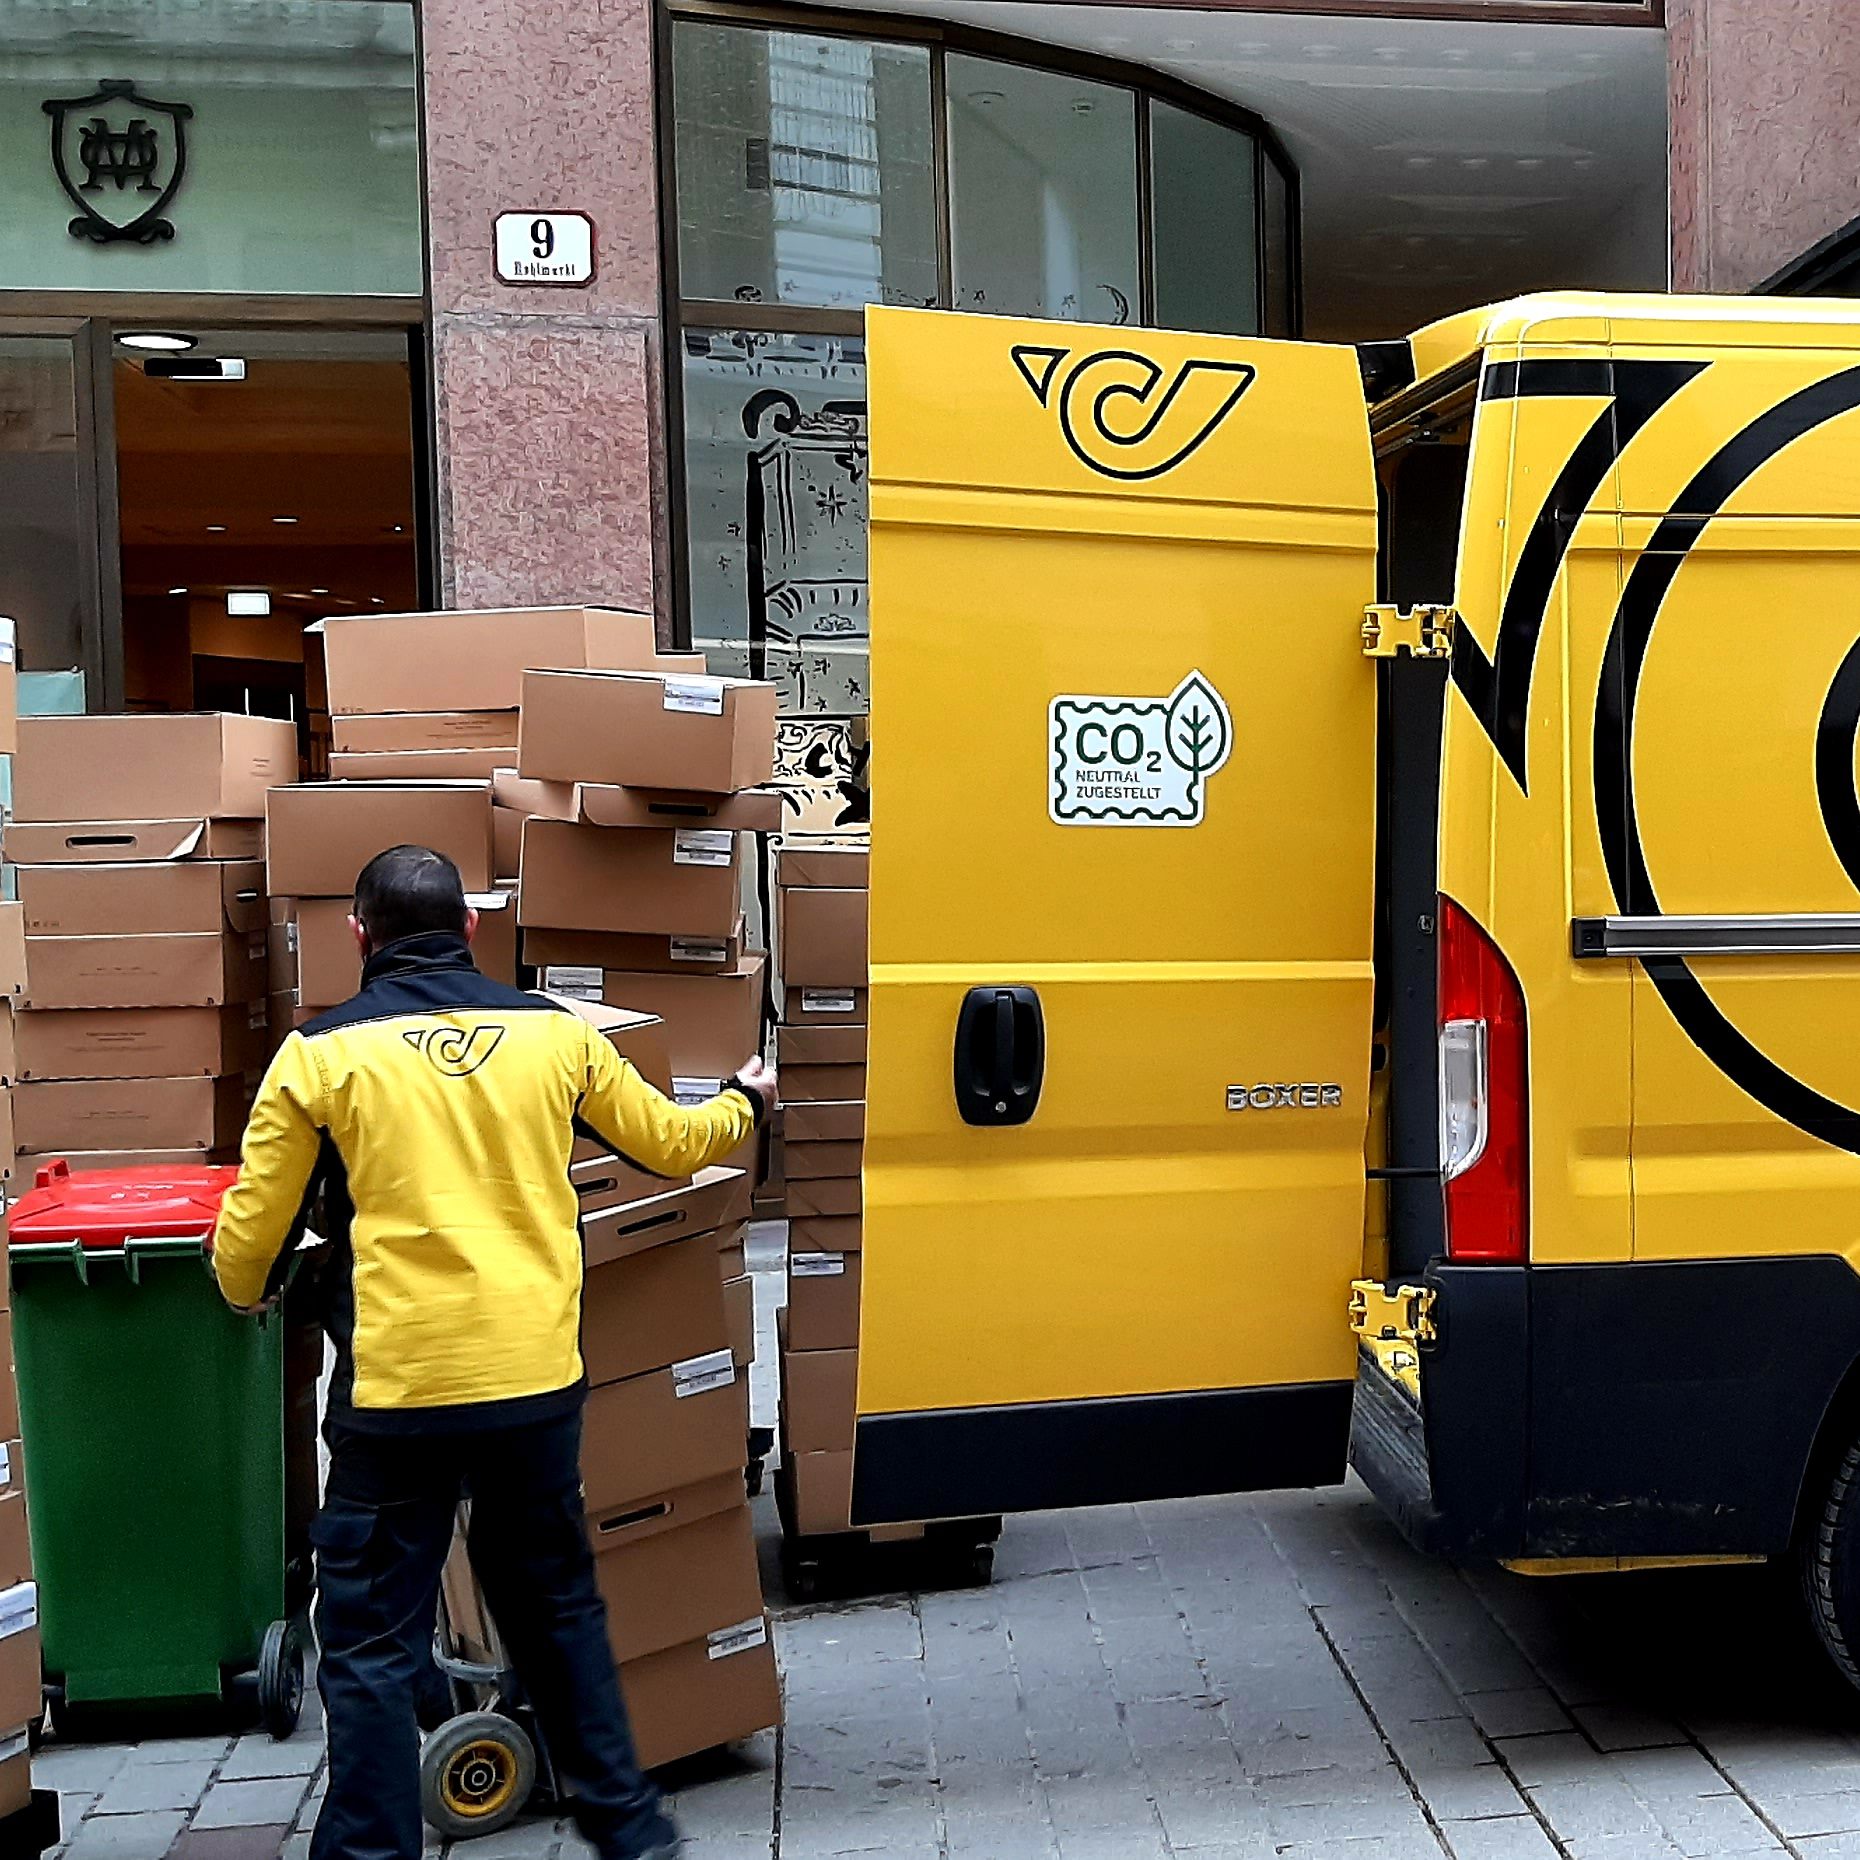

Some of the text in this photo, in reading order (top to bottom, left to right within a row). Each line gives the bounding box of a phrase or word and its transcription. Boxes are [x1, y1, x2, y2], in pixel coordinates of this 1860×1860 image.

[530, 218, 554, 259] 9
[1075, 769, 1141, 783] NEUTRAL
[1076, 786, 1162, 799] ZUGESTELLT
[1226, 1083, 1342, 1111] BOXER
